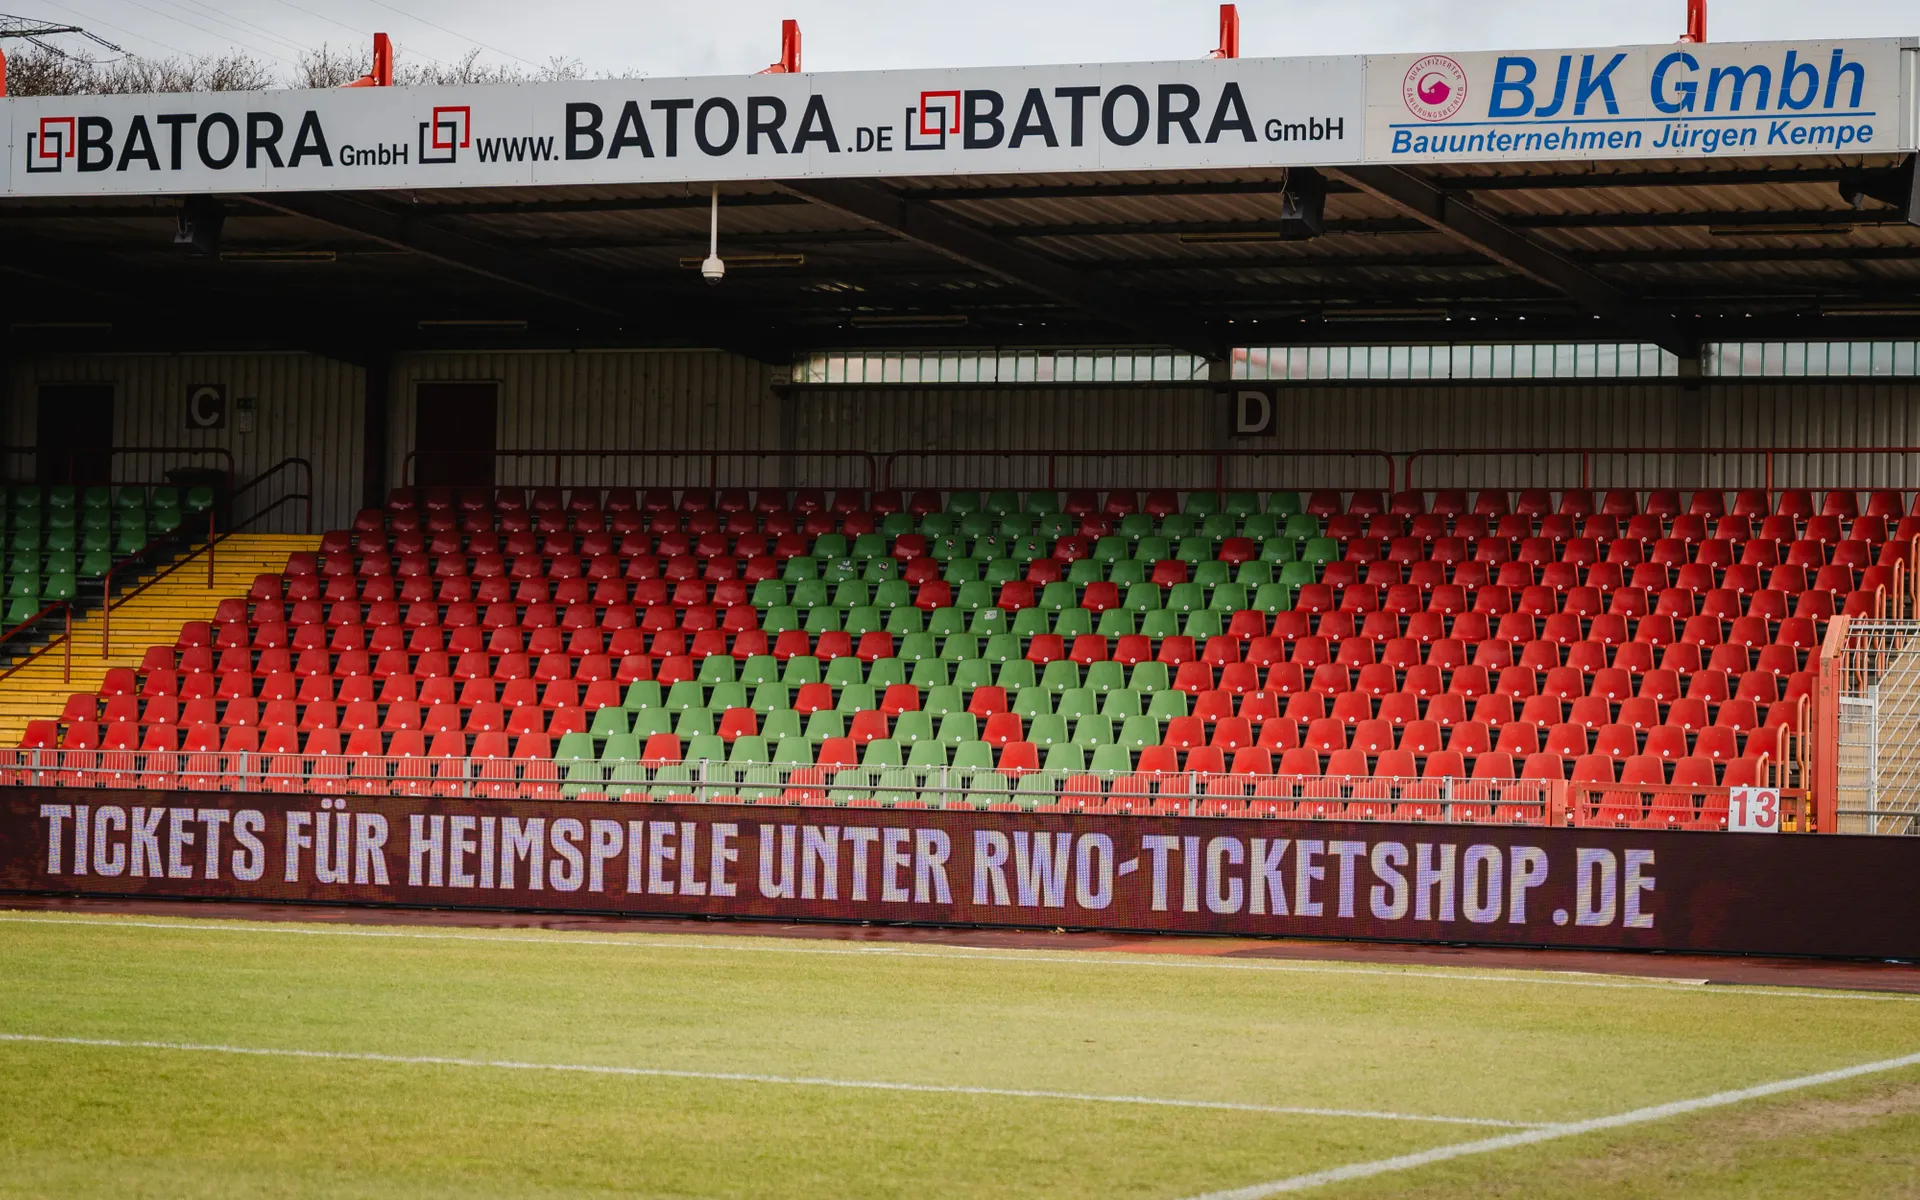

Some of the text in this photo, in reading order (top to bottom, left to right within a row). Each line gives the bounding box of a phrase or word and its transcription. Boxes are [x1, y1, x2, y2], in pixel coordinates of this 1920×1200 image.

[1408, 58, 1462, 82] QUALIFIZIERTER
[1487, 49, 1866, 118] BJK Gmbh
[1406, 86, 1464, 118] SANIERUNGSBETRIEB
[76, 81, 1344, 173] BATORA GmbH www.BATORA.DE BATORA GmbH
[1391, 119, 1873, 154] Bauunternehmen Jürgen Kempe
[191, 387, 220, 426] C
[1237, 390, 1271, 433] D
[1732, 791, 1776, 828] 13
[40, 798, 1656, 930] TICKETS FÜR HEIMSPIELE UNTER RWO-TICKETSHOP.DE
